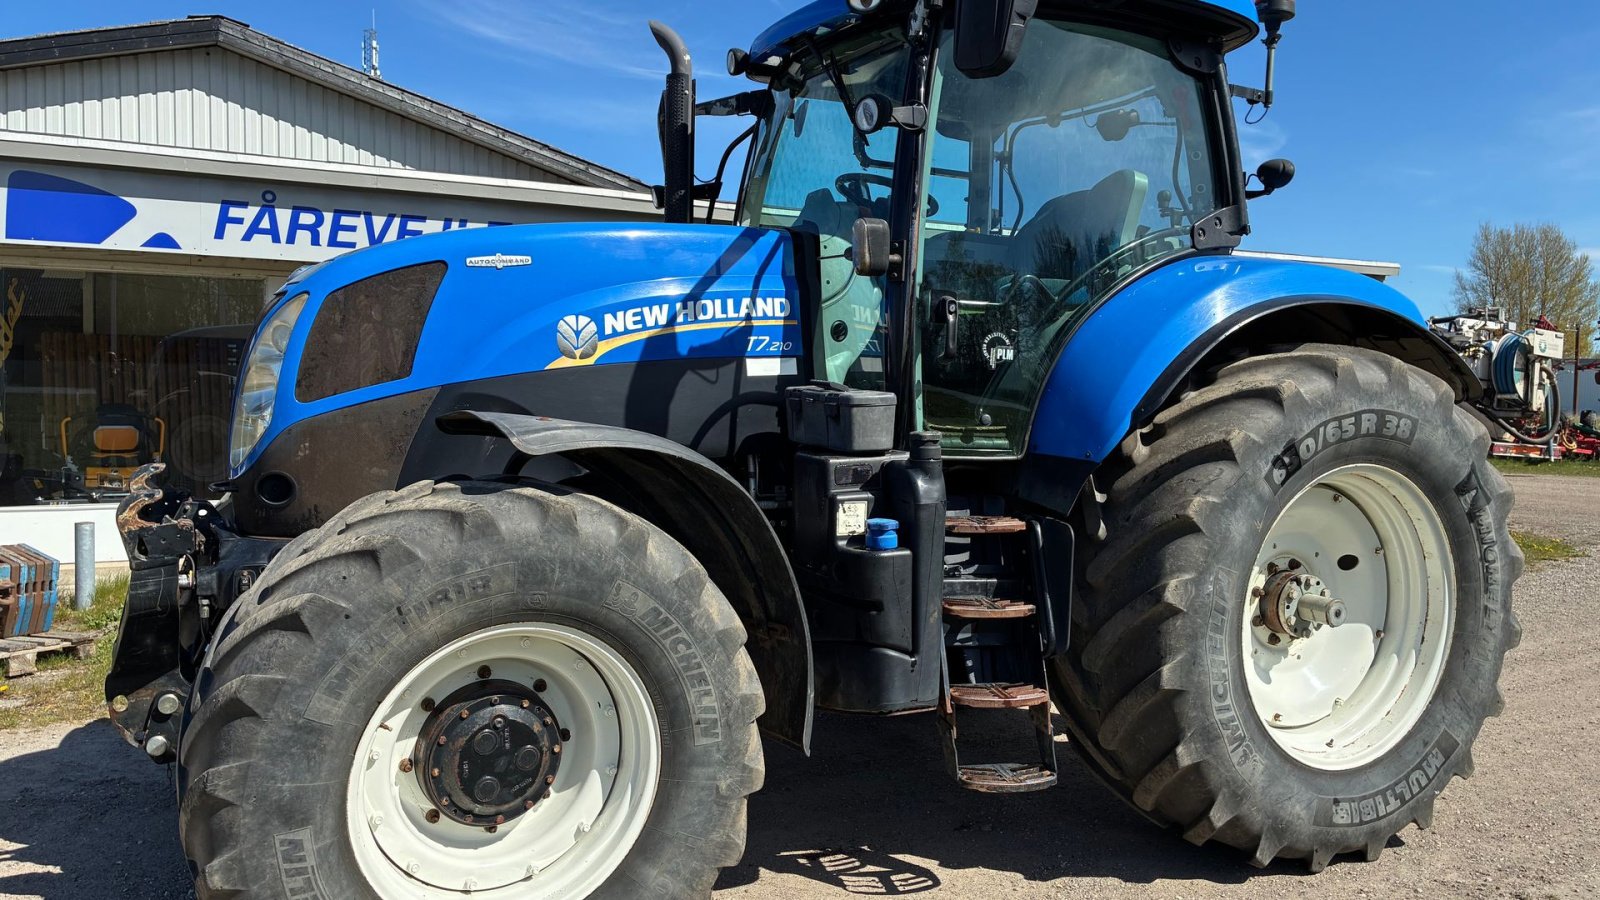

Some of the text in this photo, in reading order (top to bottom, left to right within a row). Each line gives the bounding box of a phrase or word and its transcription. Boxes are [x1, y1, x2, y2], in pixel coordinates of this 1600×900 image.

[213, 190, 513, 249] FÅREVE
[468, 257, 530, 265] AUTOCOMMAND
[604, 297, 790, 335] NEW HOLLAND
[996, 348, 1014, 361] PLM
[1361, 413, 1377, 435] R
[1382, 414, 1413, 439] 38
[641, 604, 722, 742] MICHELIN
[1209, 572, 1247, 753] MICHELIN
[1332, 747, 1445, 825] MULTIBIB
